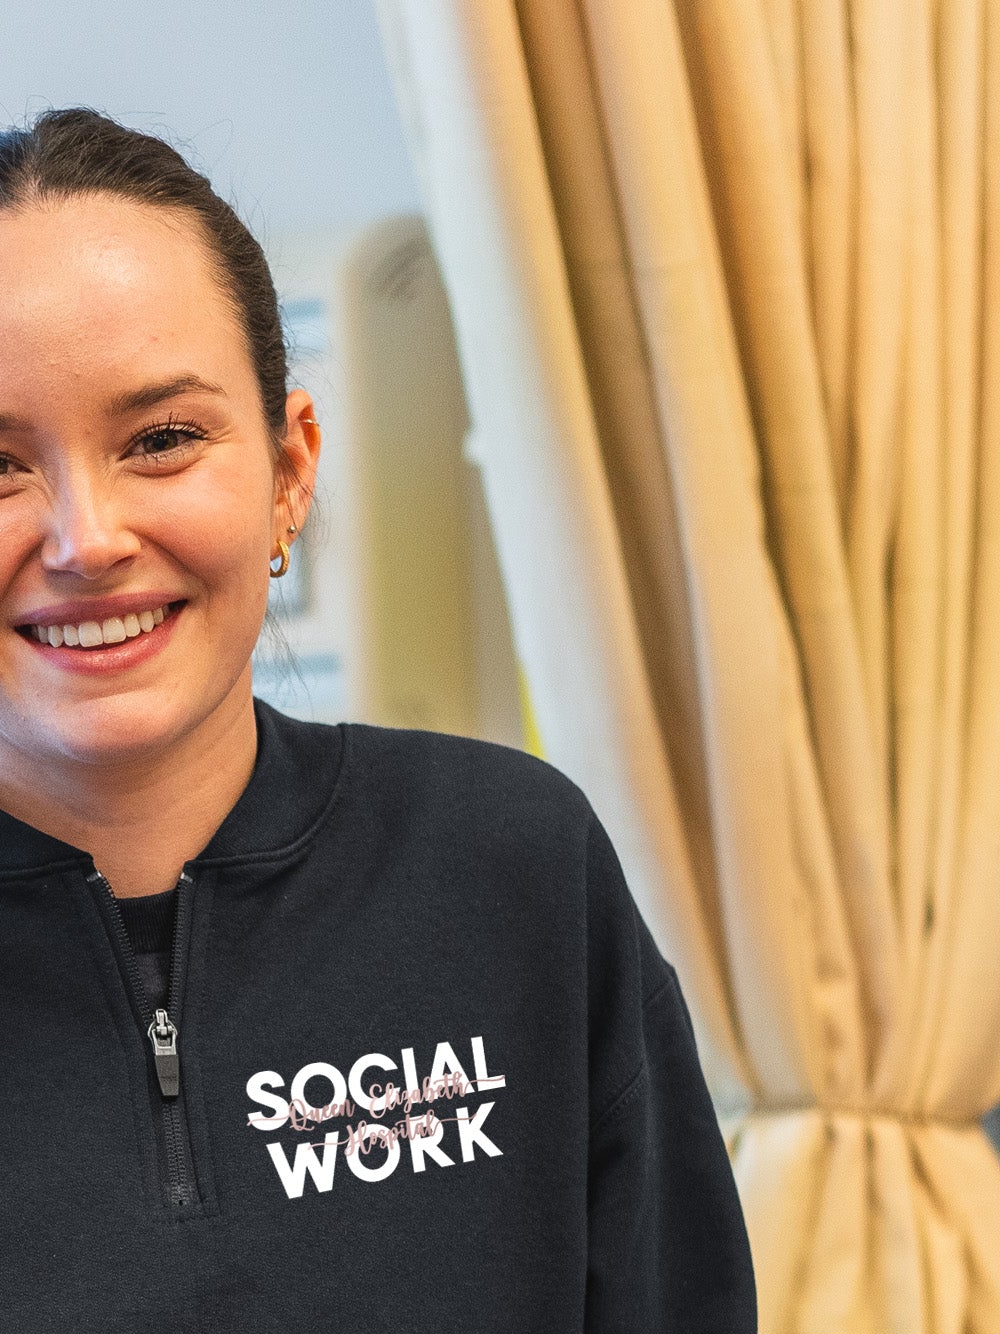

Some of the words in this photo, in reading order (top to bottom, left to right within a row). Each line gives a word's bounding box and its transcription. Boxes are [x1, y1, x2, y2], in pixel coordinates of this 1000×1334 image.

[246, 1036, 506, 1131] SOCIAL
[247, 1098, 355, 1131] Queen
[369, 1071, 505, 1120] Elizabeth
[266, 1101, 504, 1199] WORK
[307, 1110, 477, 1157] Hospital
